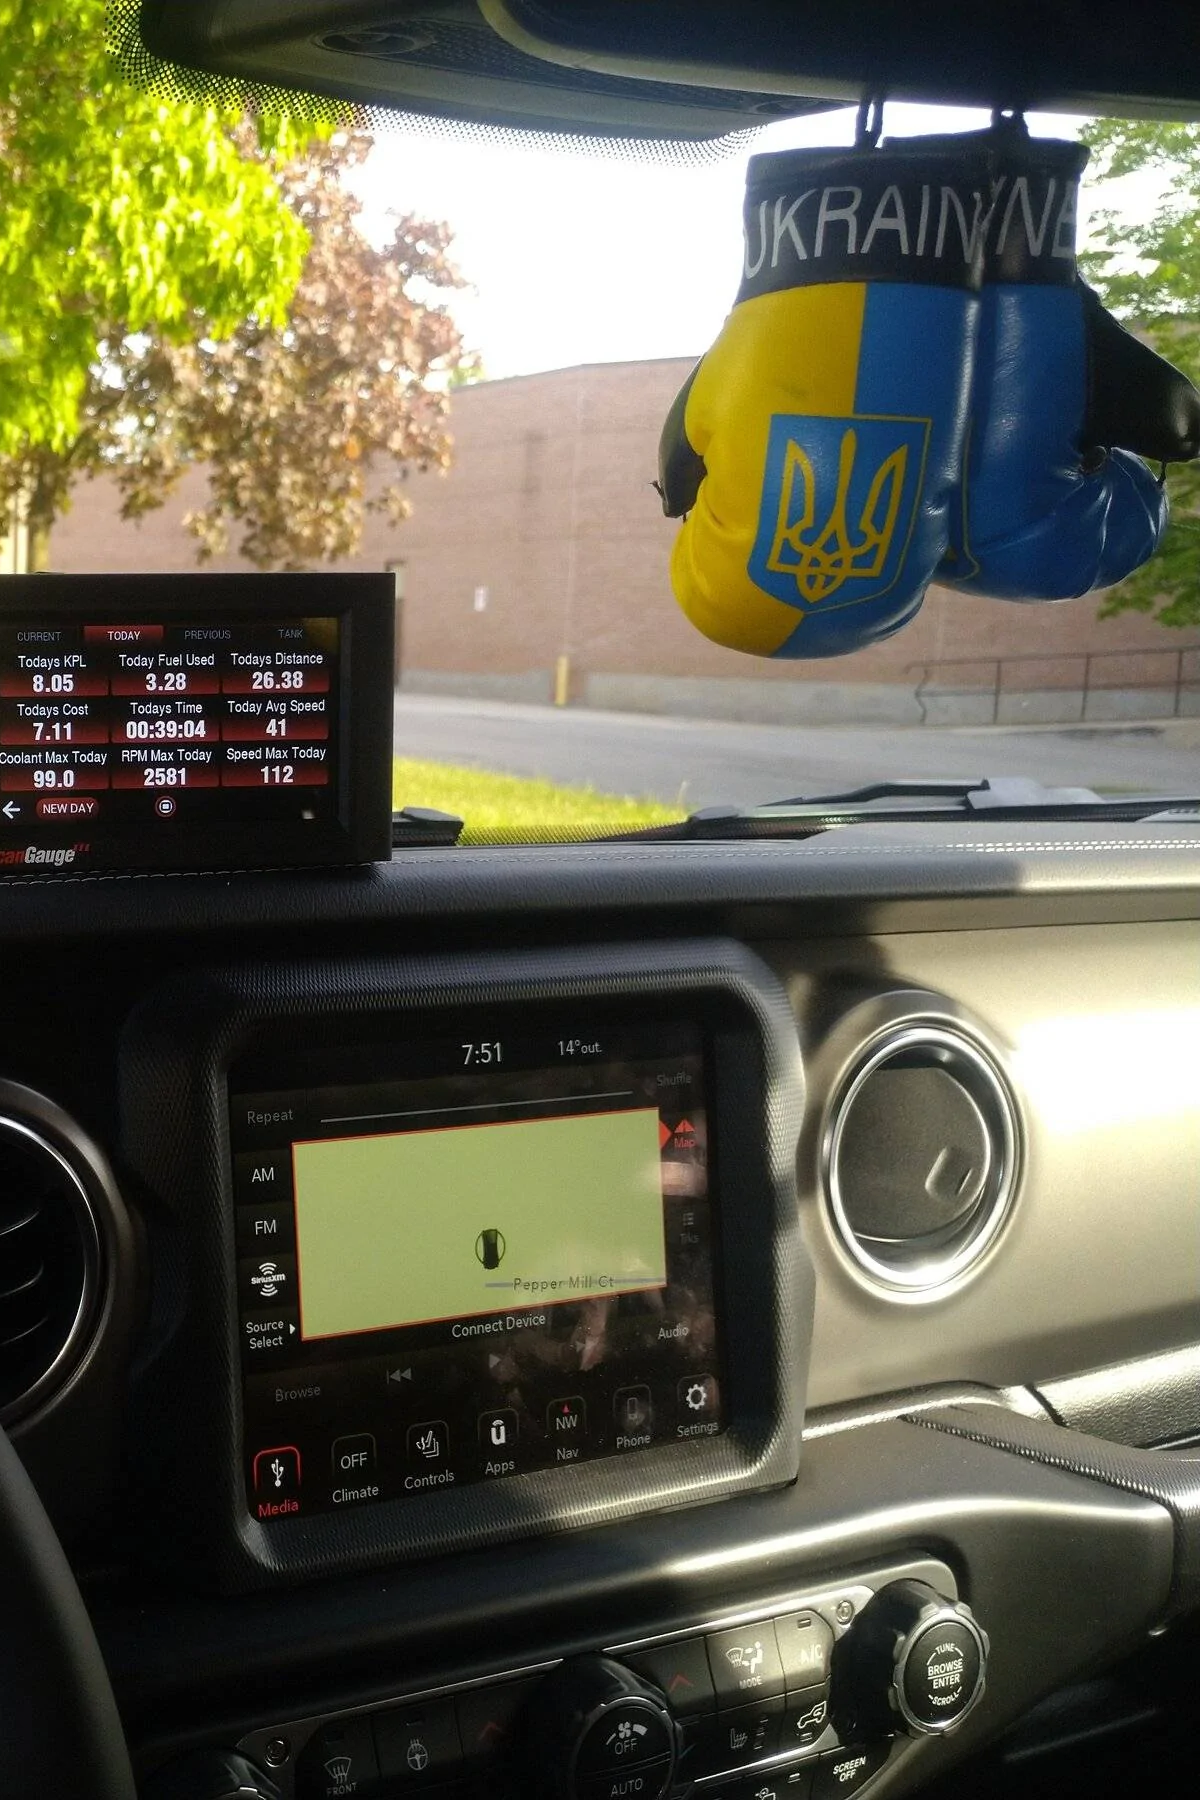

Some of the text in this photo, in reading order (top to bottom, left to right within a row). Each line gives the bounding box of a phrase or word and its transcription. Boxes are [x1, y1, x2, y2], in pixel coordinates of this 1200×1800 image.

[17, 631, 61, 642] CURRENT
[107, 630, 141, 641] TODAY
[184, 630, 231, 640] PREVIOUS
[278, 628, 304, 639] TANK
[18, 655, 87, 669] Todays KPL
[119, 653, 215, 668] Today Fuel Used
[230, 652, 323, 667] Todays Distance
[32, 673, 74, 693] 8.05
[145, 672, 187, 691] 3.28
[252, 671, 304, 690] 26.38
[17, 703, 89, 718] Todays Cost
[131, 702, 203, 716] Todays Time
[228, 699, 325, 714] Today Avg Speed
[33, 722, 73, 741] 7.11
[126, 720, 206, 739] 00:39:04
[265, 718, 287, 737] 41
[45, 751, 70, 763] Max
[73, 750, 107, 765] Today
[121, 748, 212, 763] RPM Max Today
[226, 747, 326, 762] Speed Max Today
[33, 769, 74, 788] 99.0
[143, 768, 188, 787] 2581
[260, 765, 294, 784] 112
[43, 802, 94, 815] NEW DAY
[461, 1042, 502, 1065] 7:51
[656, 1071, 692, 1087] Shuffle
[247, 1108, 293, 1126] Repeat
[674, 1136, 695, 1149] Map
[251, 1166, 275, 1183] AM
[254, 1219, 277, 1235] FM
[513, 1274, 615, 1292] Pepper Mill Ct
[246, 1318, 284, 1335] Source
[452, 1312, 546, 1338] Connect Device
[658, 1324, 689, 1340] Audio
[249, 1333, 284, 1349] Select
[275, 1384, 321, 1402] Browse
[556, 1413, 577, 1430] NW
[676, 1418, 718, 1439] Settings
[616, 1432, 651, 1448] Phone
[340, 1451, 368, 1469] OFF
[557, 1446, 578, 1461] Nav
[485, 1458, 515, 1476] Apps
[404, 1469, 455, 1489] Controls
[332, 1482, 379, 1503] Climate
[258, 1499, 299, 1518] Media
[800, 1644, 823, 1665] A/C
[935, 1642, 956, 1656] TUNE
[927, 1658, 963, 1676] BROWSE
[739, 1676, 763, 1690] MODE
[932, 1673, 961, 1689] ENTER
[931, 1690, 960, 1706] SCROLL
[615, 1738, 638, 1755] OFF
[832, 1756, 867, 1774] SCREEN
[839, 1769, 857, 1783] OFF
[326, 1781, 357, 1797] FRONT
[610, 1777, 643, 1798] AUTO
